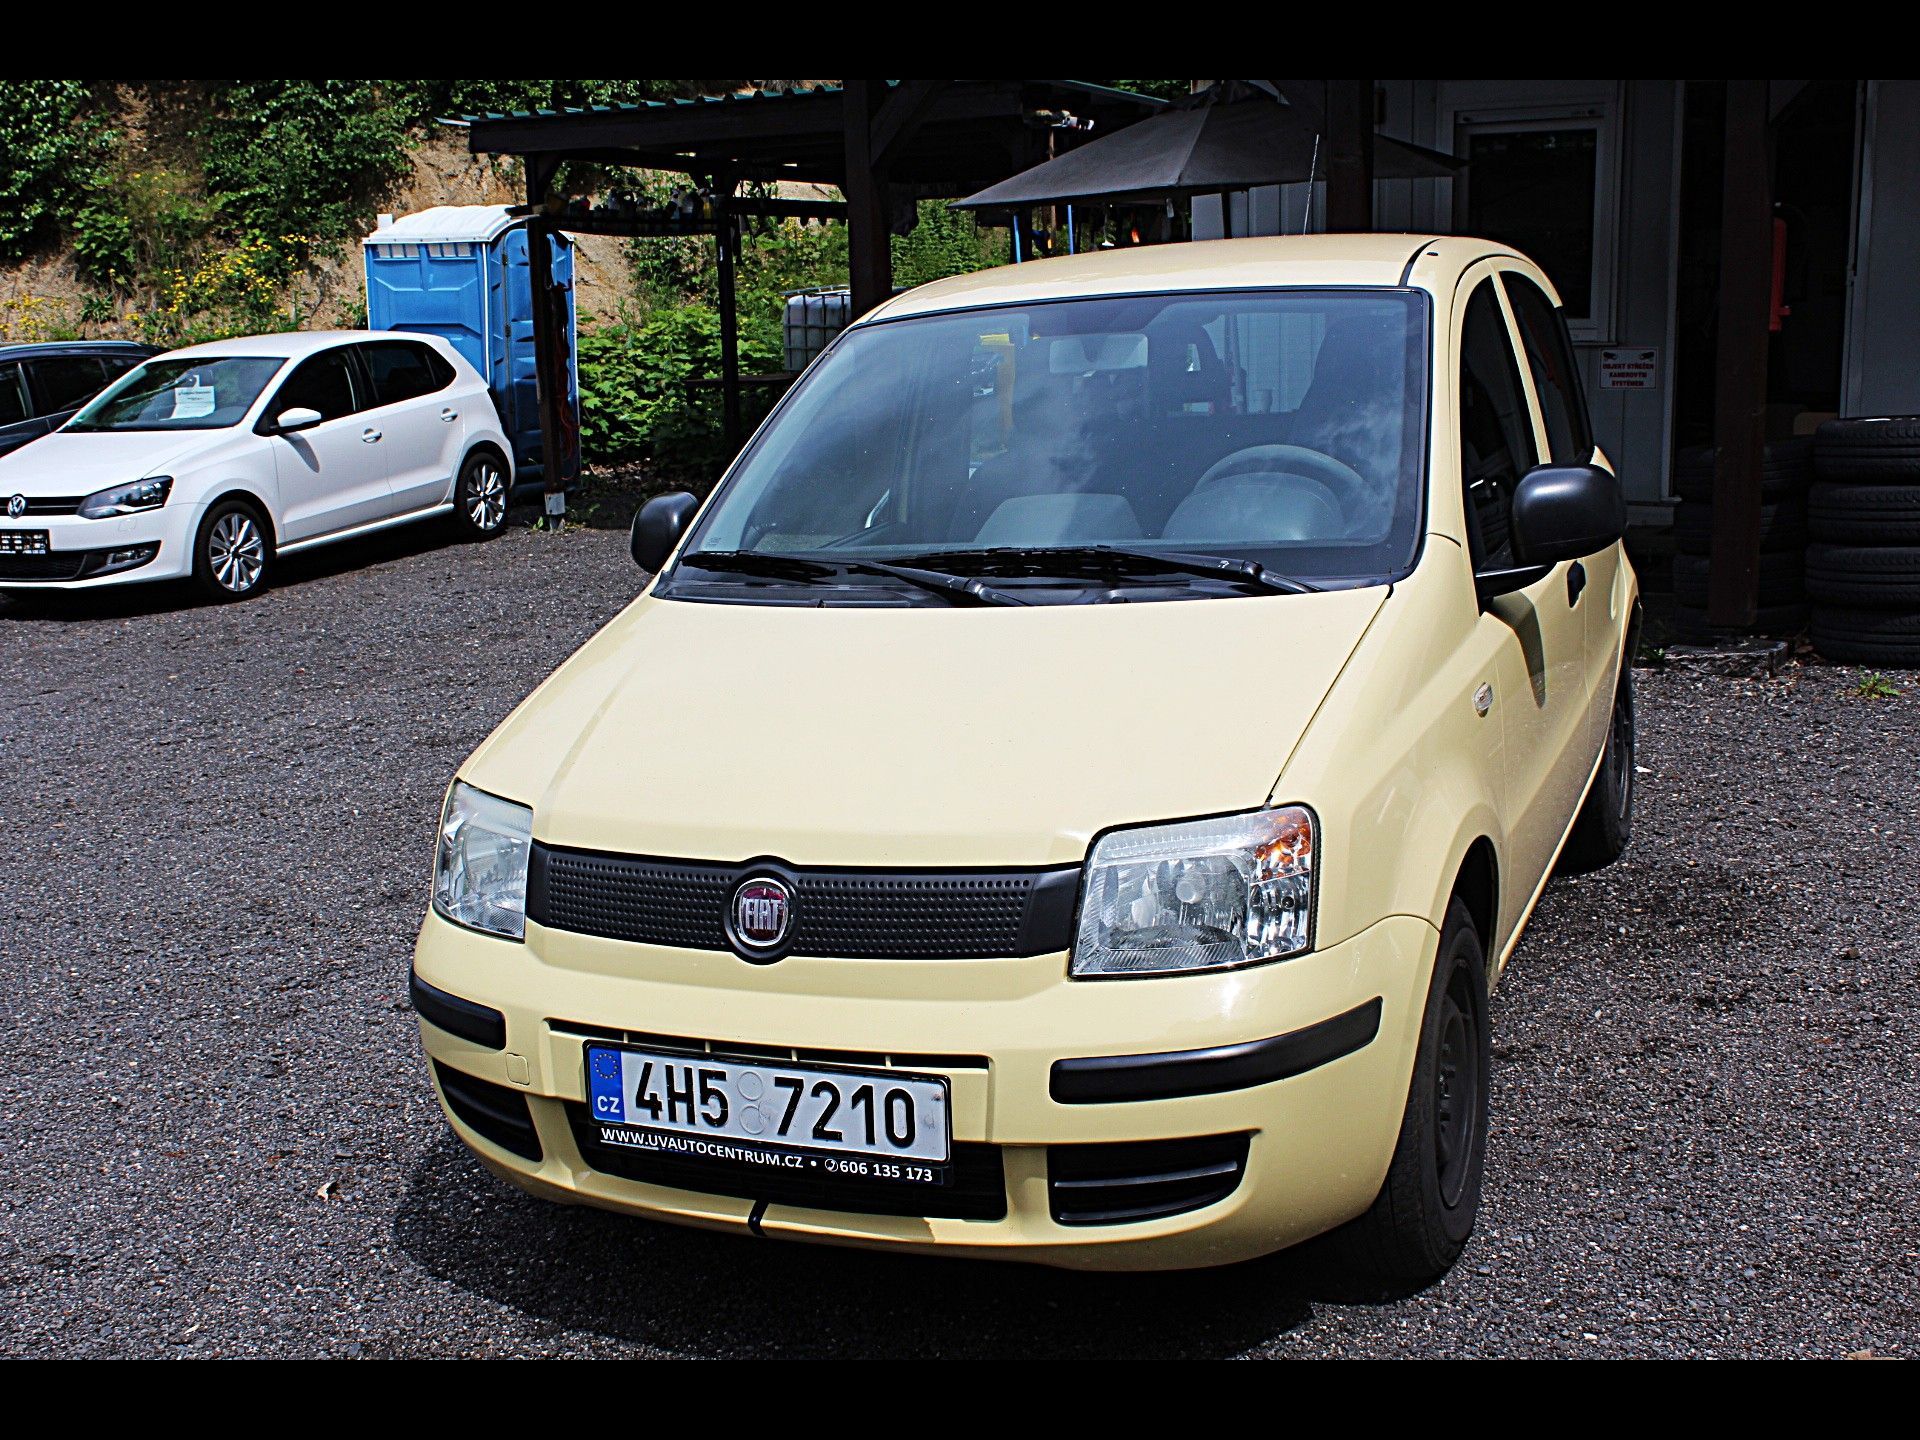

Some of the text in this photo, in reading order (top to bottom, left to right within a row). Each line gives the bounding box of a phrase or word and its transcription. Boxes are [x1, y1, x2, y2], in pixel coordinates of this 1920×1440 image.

[742, 898, 783, 930] FIAT
[597, 1095, 620, 1113] CZ
[635, 1061, 916, 1149] 4H5 7210
[600, 1127, 933, 1182] WWW.UVAUTOCENTRUM.CZ 606 135 173
